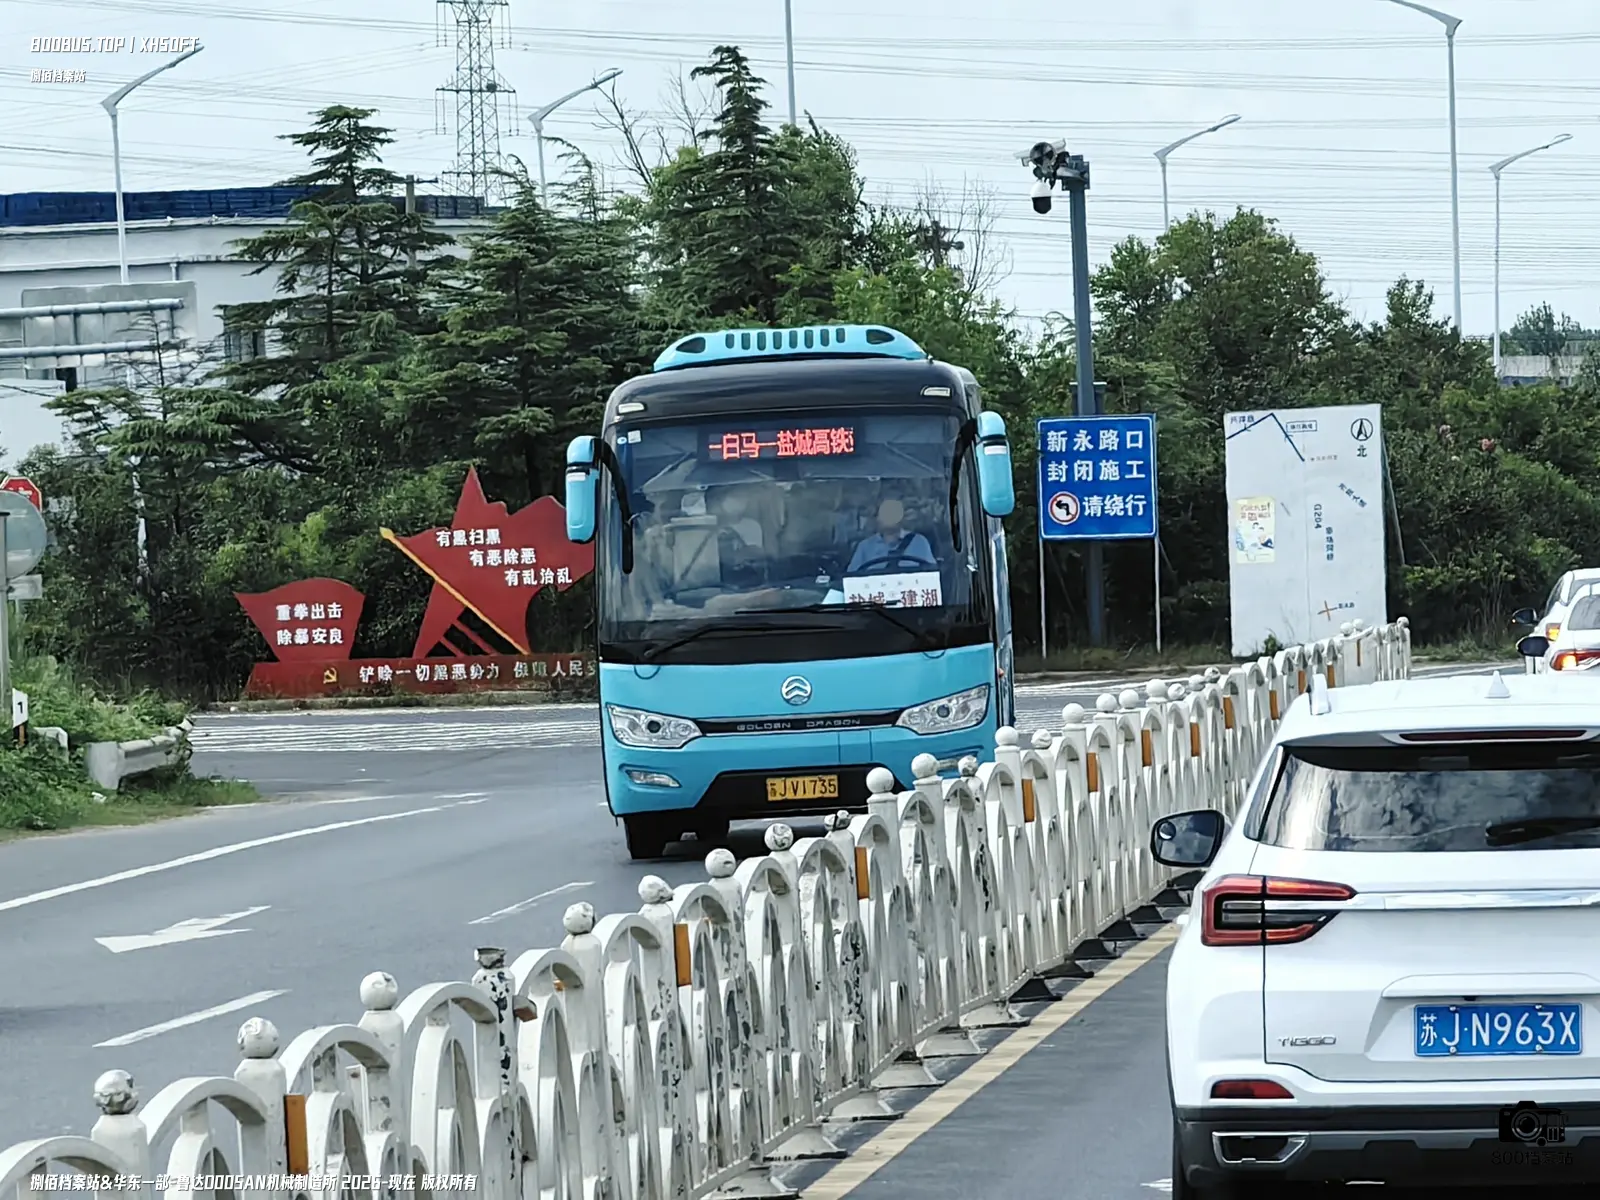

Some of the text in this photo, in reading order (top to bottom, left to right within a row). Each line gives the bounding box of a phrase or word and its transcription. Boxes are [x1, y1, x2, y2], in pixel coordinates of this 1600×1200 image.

[1047, 429, 1143, 452] 新永路口
[1357, 445, 1367, 457] 北
[1047, 460, 1146, 482] 封闭施工
[1082, 494, 1147, 517] 请绕行
[1314, 503, 1322, 529] G204
[436, 528, 501, 547] 有黑扫黑
[469, 547, 536, 566] 有恶除恶
[504, 567, 572, 586] 有乱治乱
[276, 627, 343, 645] 除暴安良
[17, 701, 23, 714] 1
[737, 719, 860, 731] GOLDEN DRAGON
